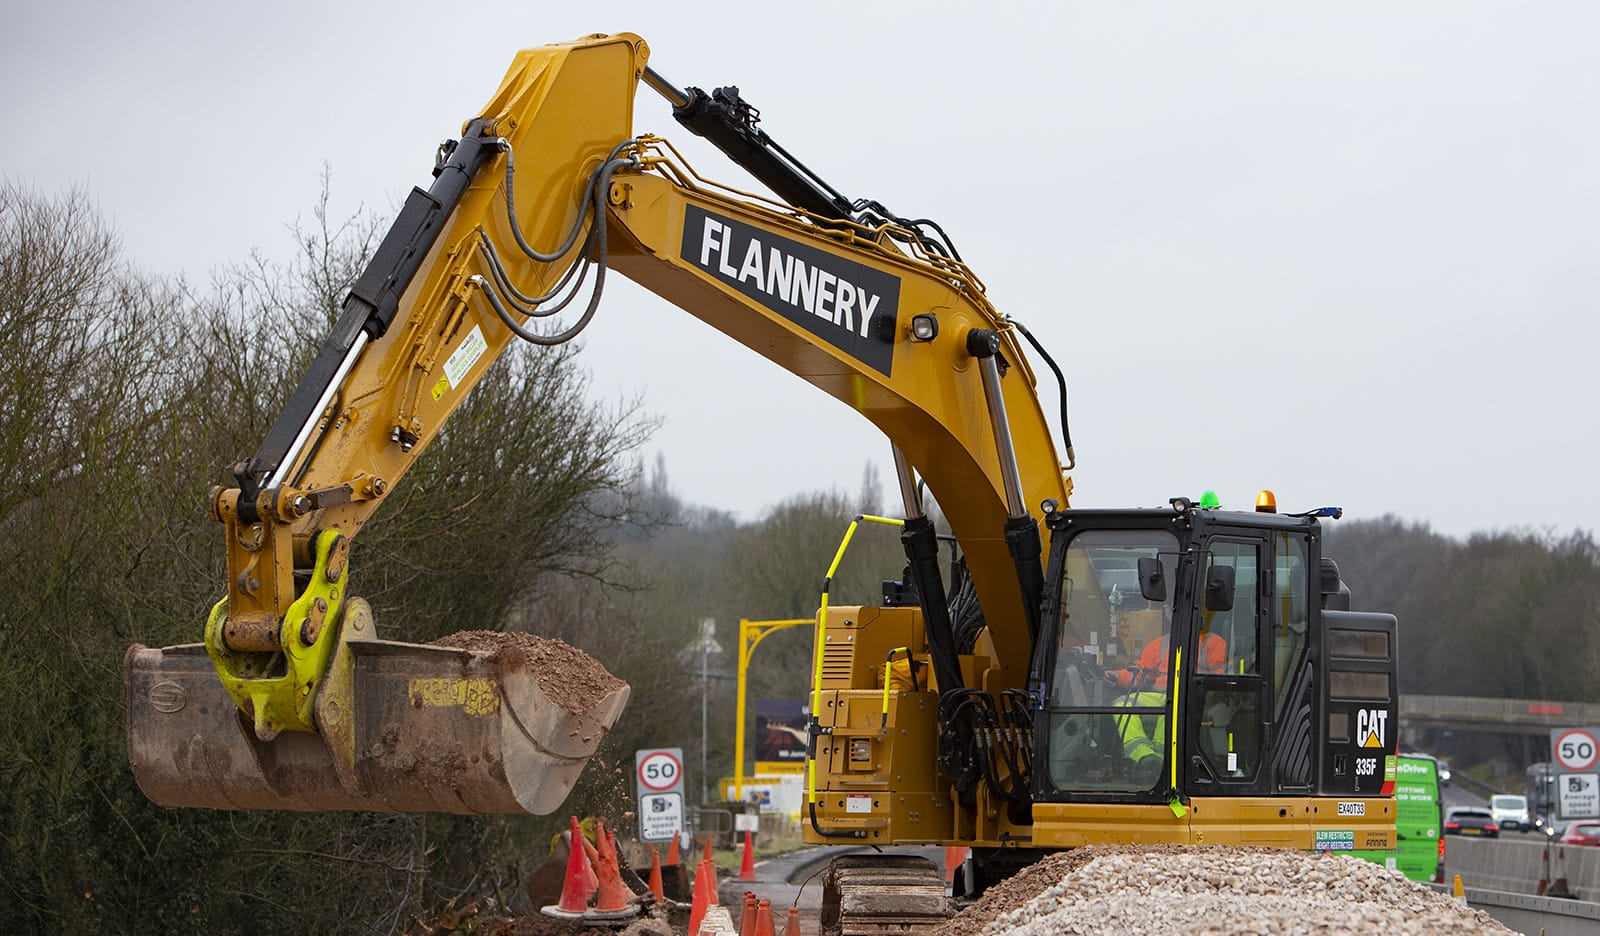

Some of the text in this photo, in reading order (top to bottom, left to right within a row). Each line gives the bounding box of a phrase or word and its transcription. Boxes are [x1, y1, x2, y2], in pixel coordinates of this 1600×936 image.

[700, 216, 881, 339] FLANNERY
[1357, 708, 1388, 748] CAT
[1562, 742, 1592, 759] 50
[647, 763, 675, 779] 50
[1355, 757, 1377, 776] 335F
[1564, 793, 1596, 801] Average
[1338, 803, 1365, 814] EX40T33
[1328, 831, 1354, 840] RESTRICTED
[1330, 841, 1354, 850] RESTRICTED
